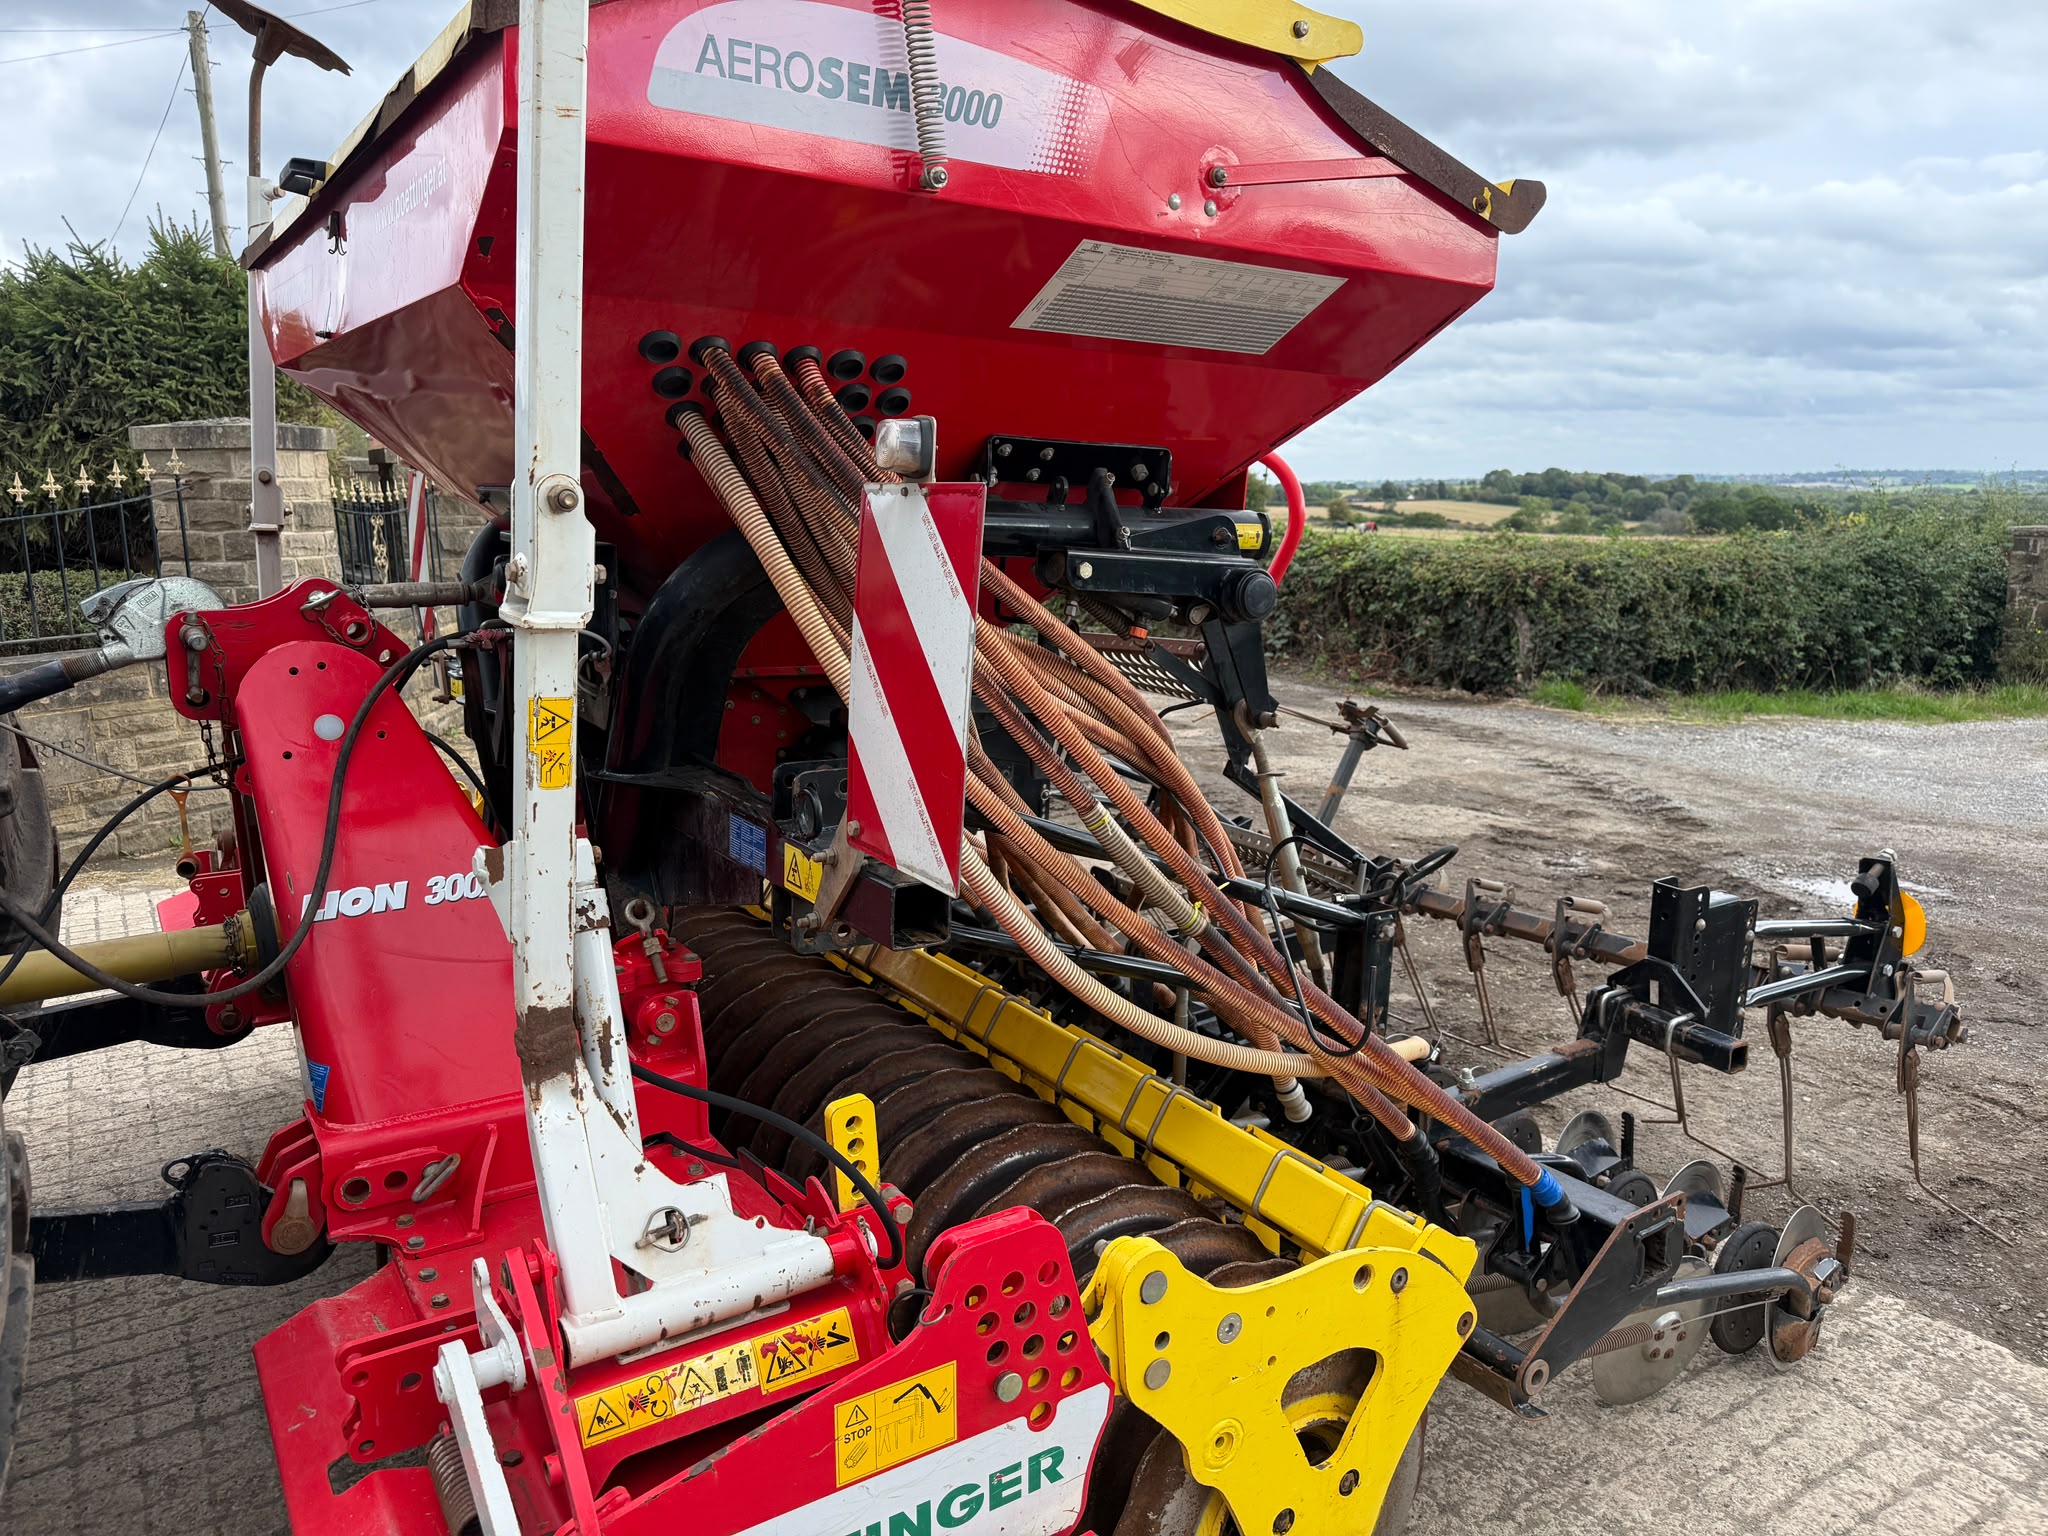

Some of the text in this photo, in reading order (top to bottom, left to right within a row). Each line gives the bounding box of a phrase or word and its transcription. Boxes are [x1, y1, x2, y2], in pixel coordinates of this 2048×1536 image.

[695, 34, 910, 112] AEROSEM
[374, 152, 446, 234] www.poettinger.at
[301, 871, 489, 922] LION 300
[844, 1425, 872, 1444] STOP
